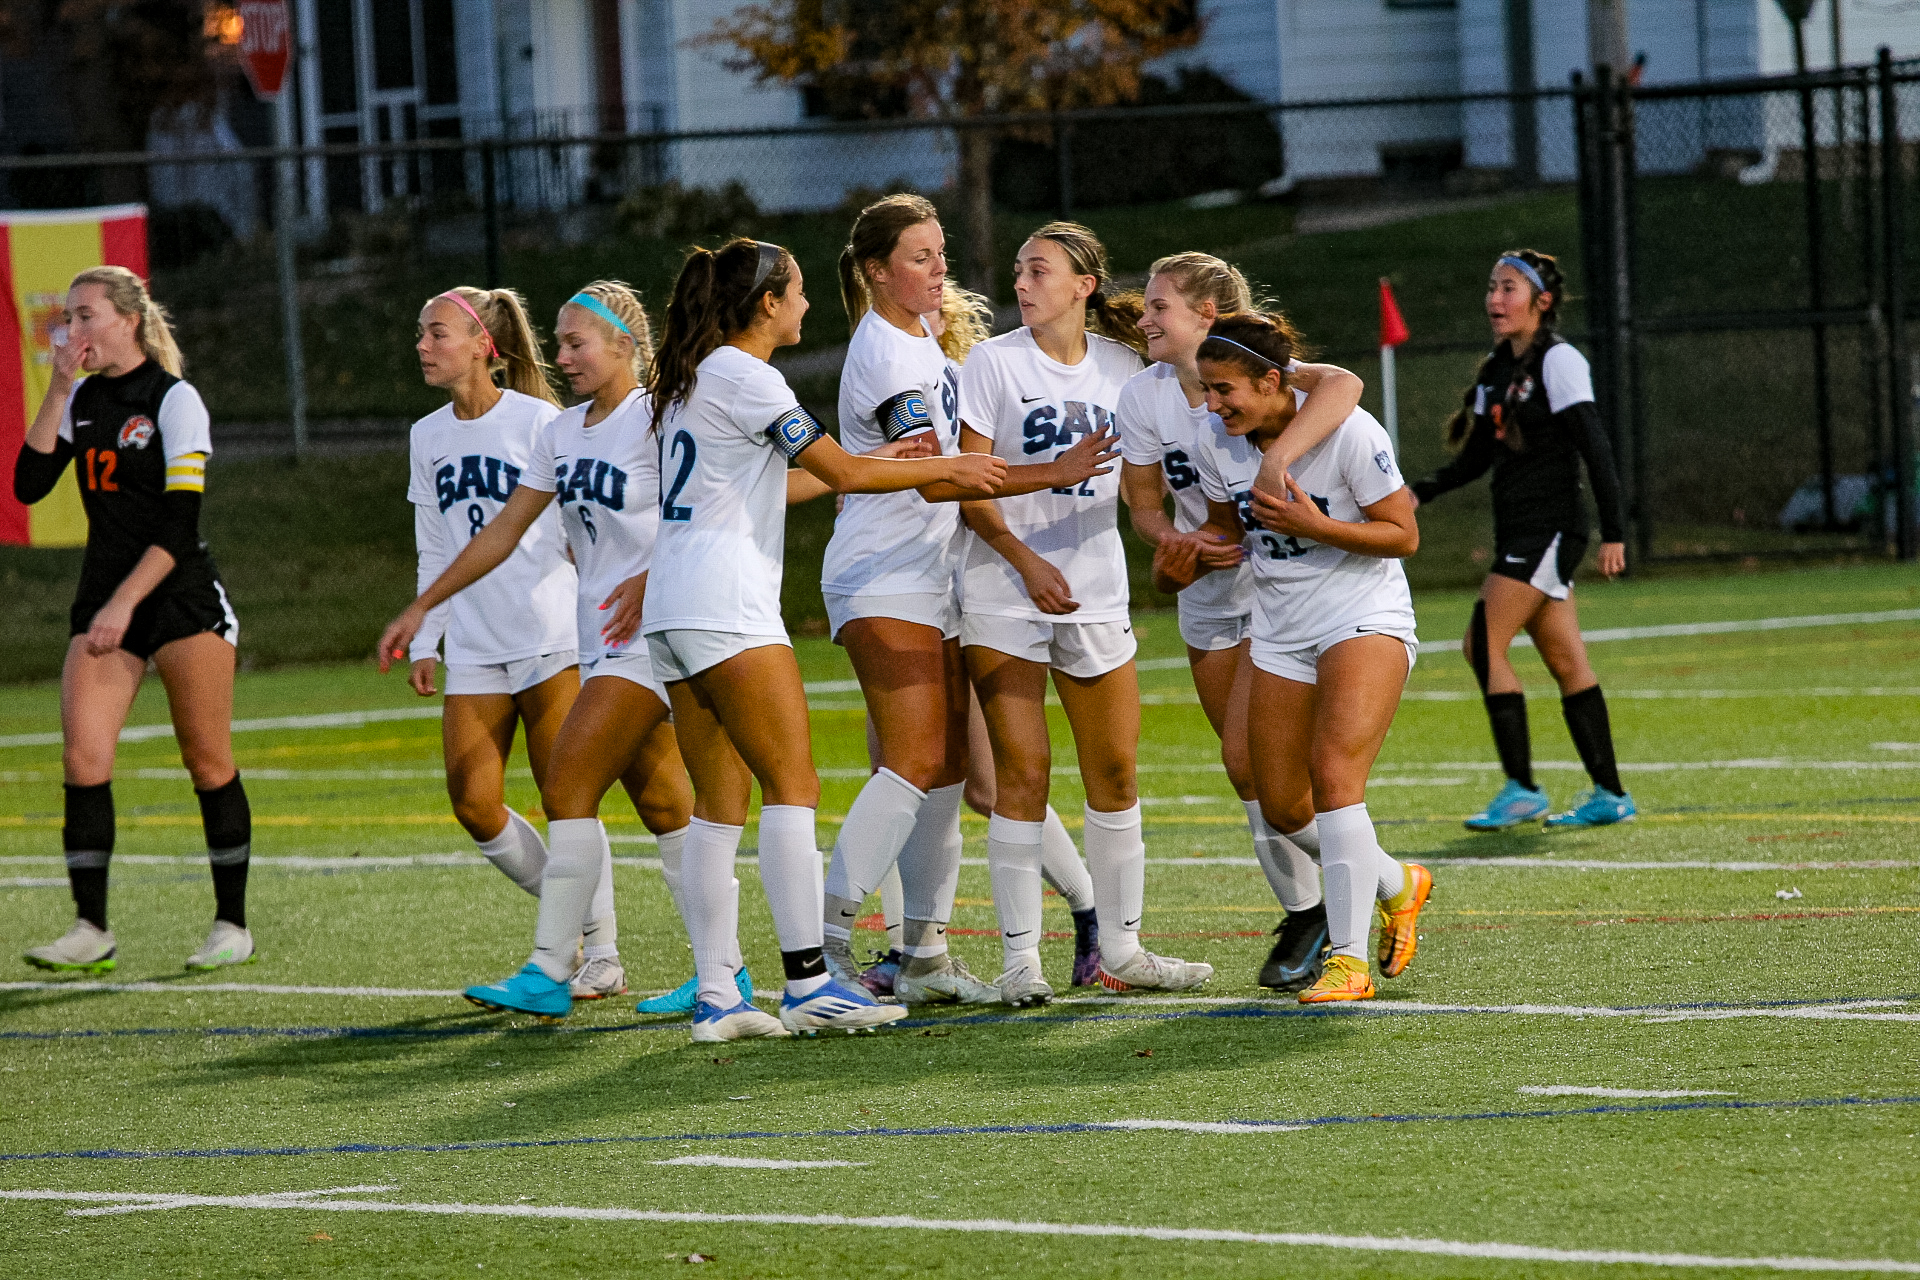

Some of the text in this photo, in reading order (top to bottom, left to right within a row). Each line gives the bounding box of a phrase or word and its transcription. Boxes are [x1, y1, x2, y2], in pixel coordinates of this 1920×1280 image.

[241, 3, 287, 53] STOP
[781, 417, 808, 445] C
[85, 448, 119, 491] 12
[436, 455, 521, 514] SAU
[555, 458, 628, 512] SAU
[467, 503, 485, 538] 8
[578, 505, 598, 545] 6
[1261, 535, 1308, 560] 21
